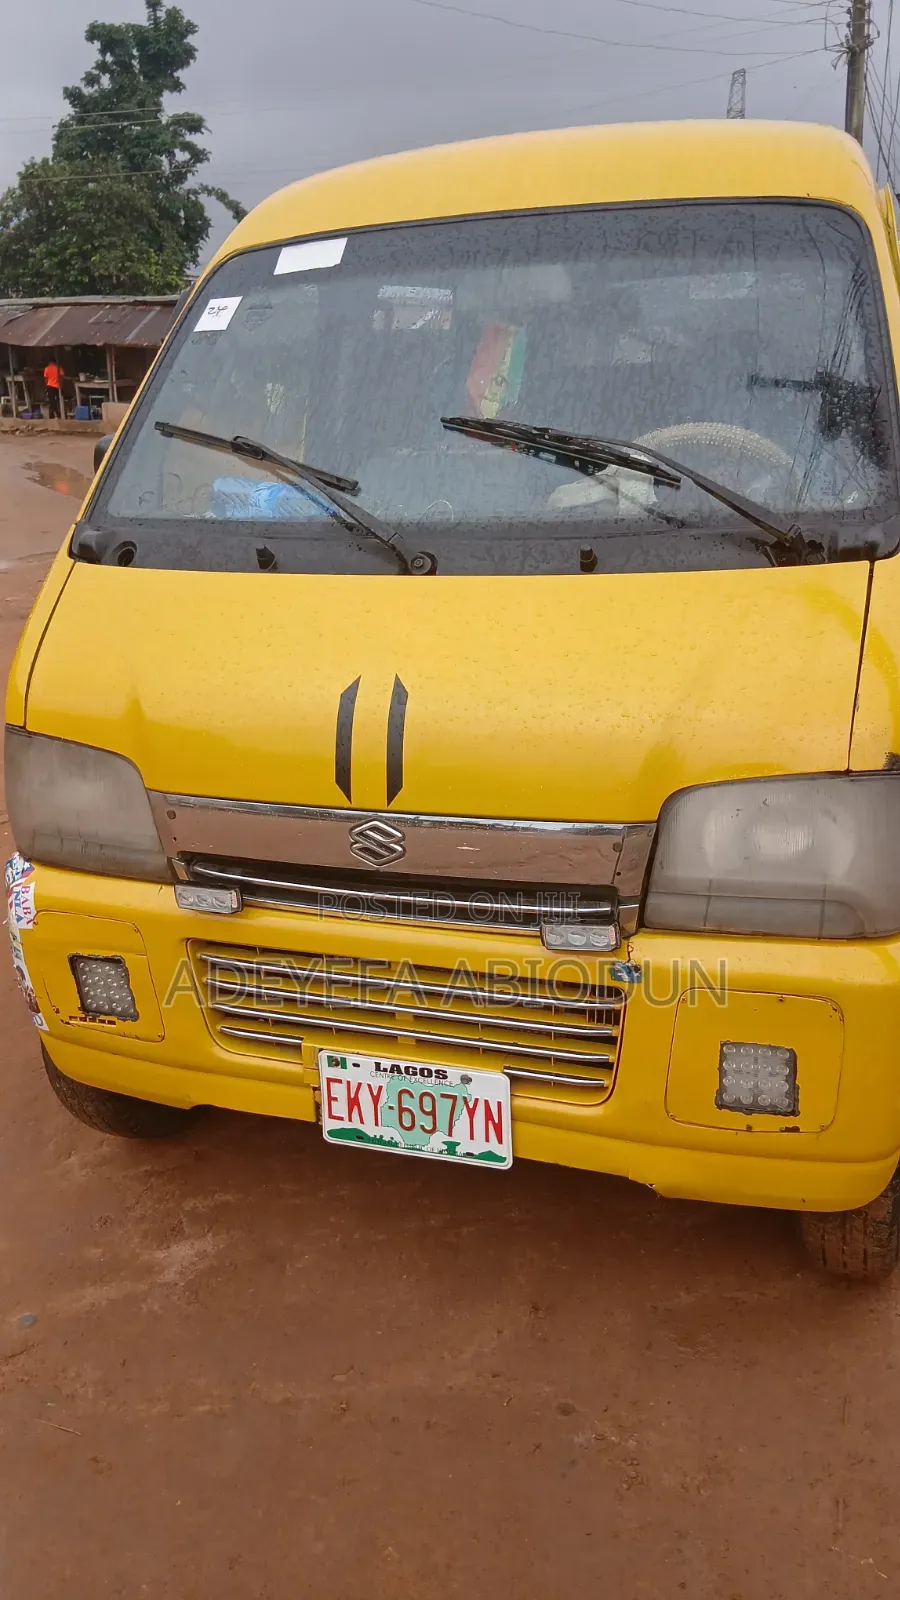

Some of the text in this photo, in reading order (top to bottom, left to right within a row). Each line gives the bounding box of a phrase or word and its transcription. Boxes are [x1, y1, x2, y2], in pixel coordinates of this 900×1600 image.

[13, 889, 24, 924] NLA
[21, 885, 34, 925] BABA
[374, 1062, 449, 1080] LAGOS
[325, 1077, 503, 1145] EKY-697YN
